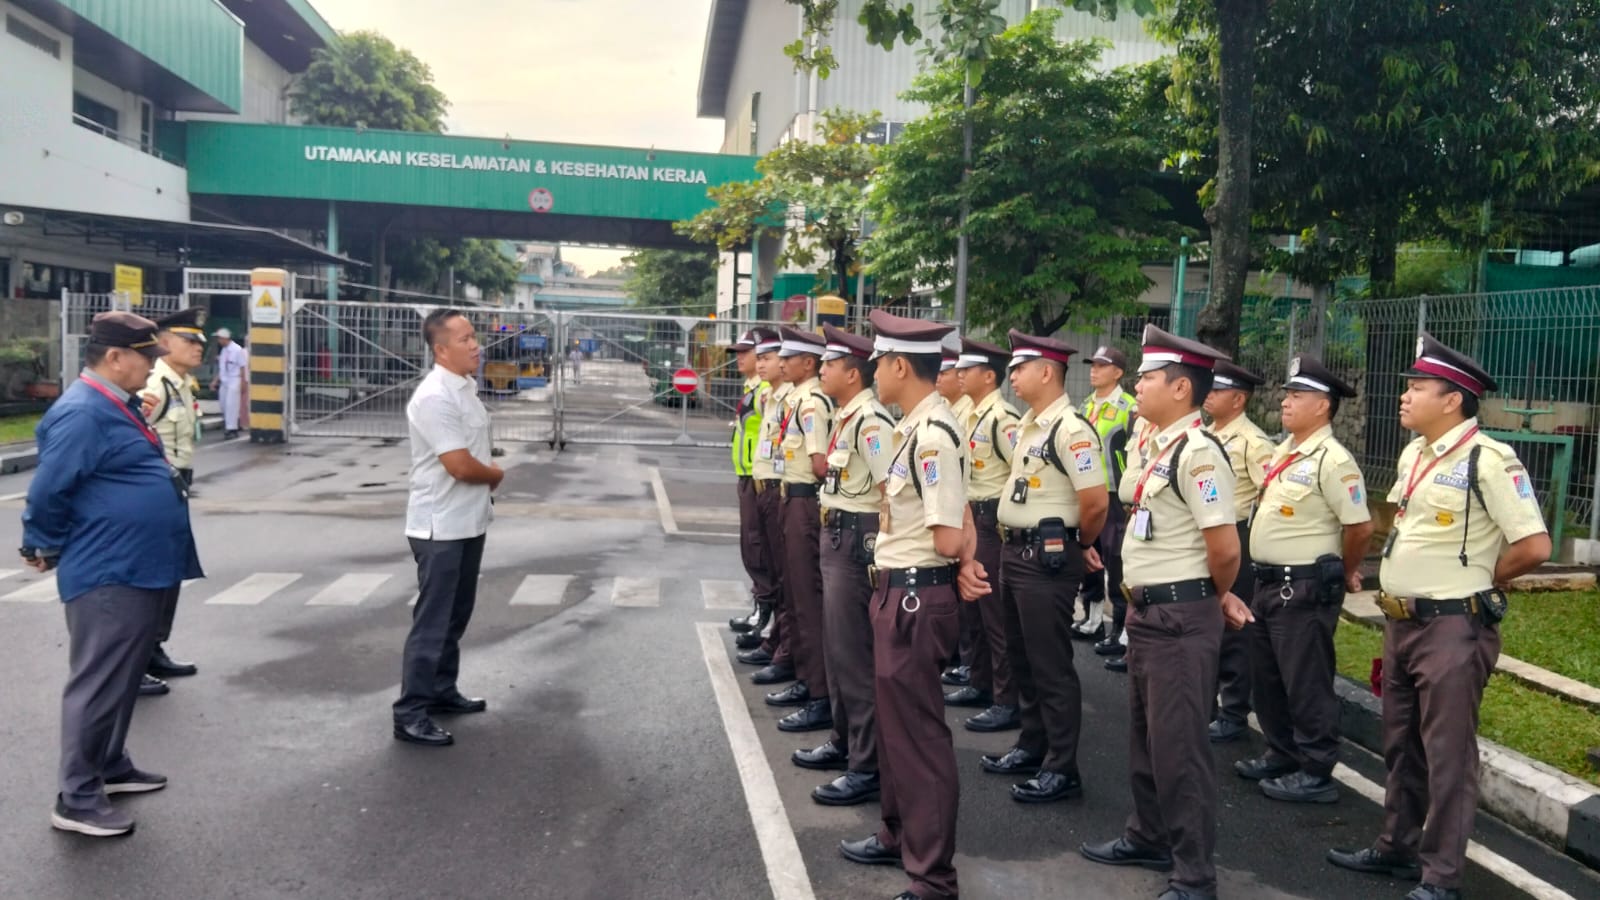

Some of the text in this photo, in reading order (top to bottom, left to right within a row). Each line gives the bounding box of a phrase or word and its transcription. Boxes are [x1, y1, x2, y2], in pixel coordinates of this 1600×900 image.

[304, 145, 707, 184] UTAMAKAN KESELAMATAN & KESEHATAN KERJA
